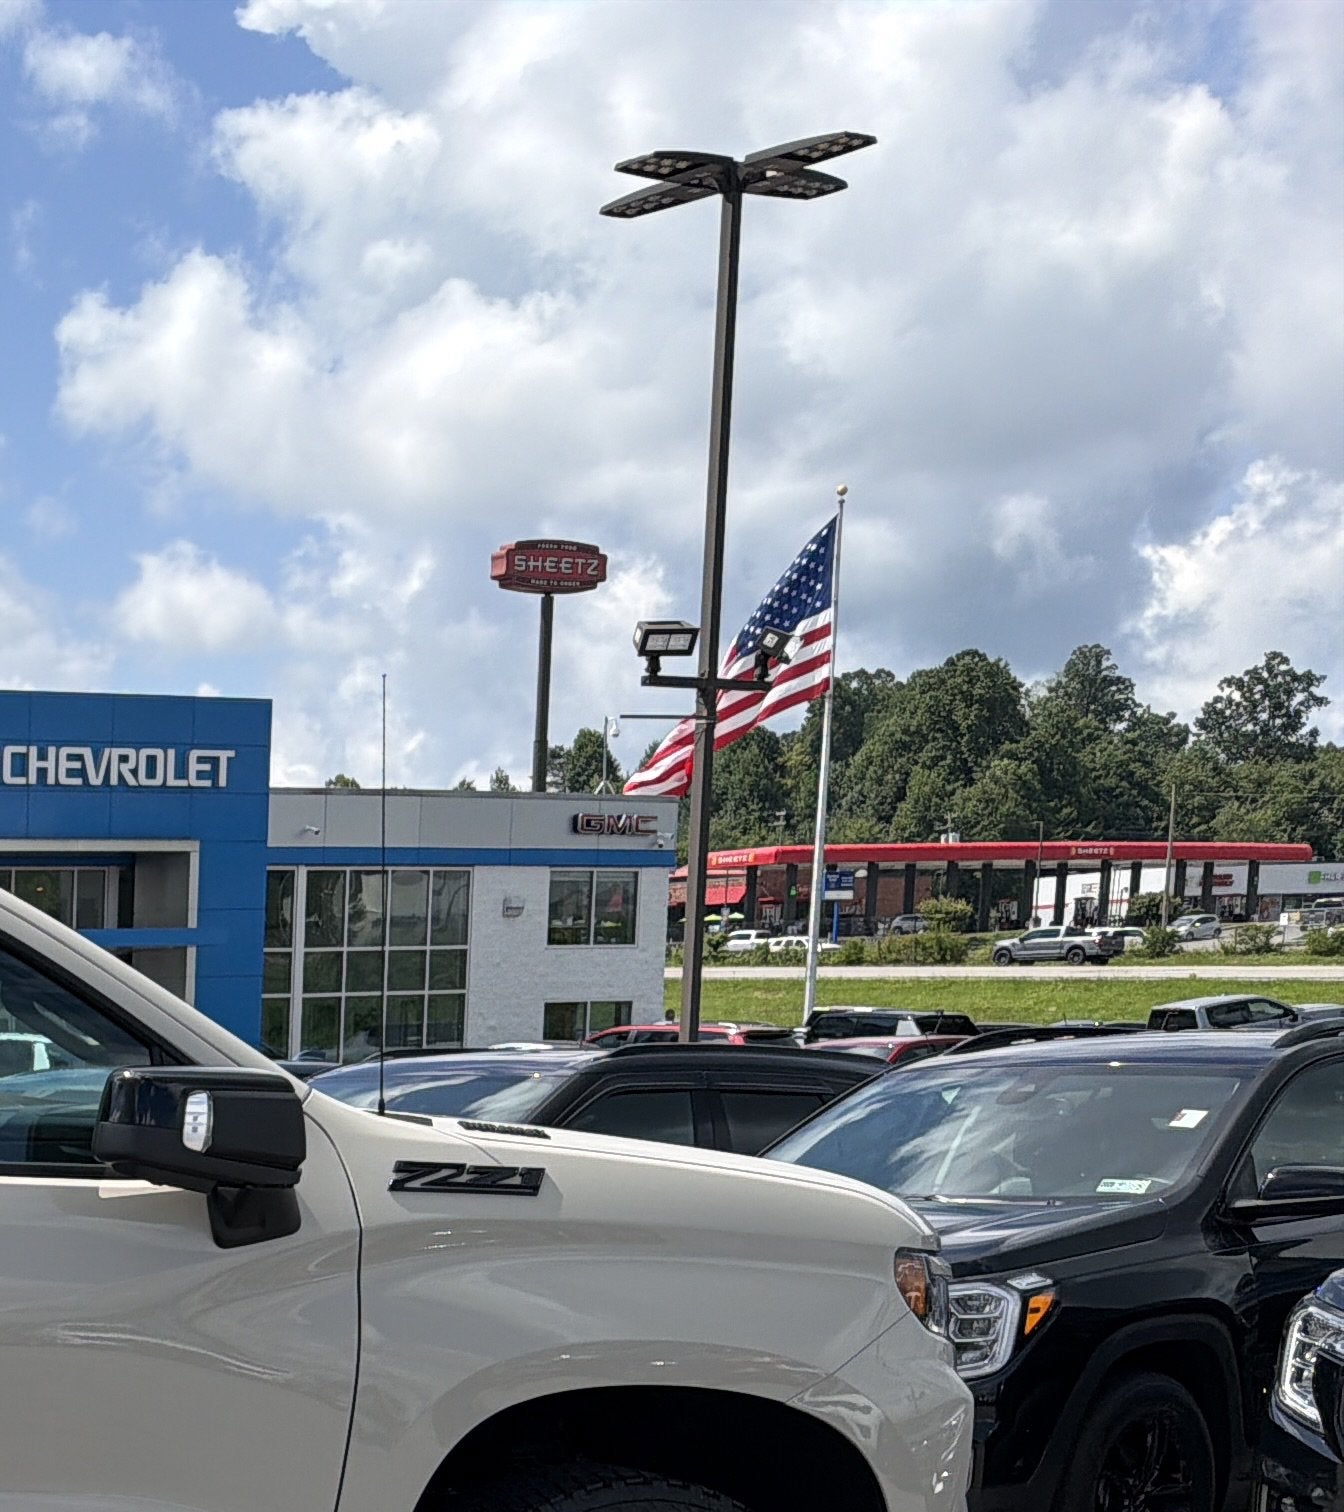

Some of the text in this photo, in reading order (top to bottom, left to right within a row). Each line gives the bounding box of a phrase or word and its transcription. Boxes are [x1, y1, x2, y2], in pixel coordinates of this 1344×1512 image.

[514, 555, 599, 575] SHEETZ
[1, 745, 237, 788] CHEVROLET
[576, 812, 658, 835] GMC
[387, 1160, 546, 1197] Z71
